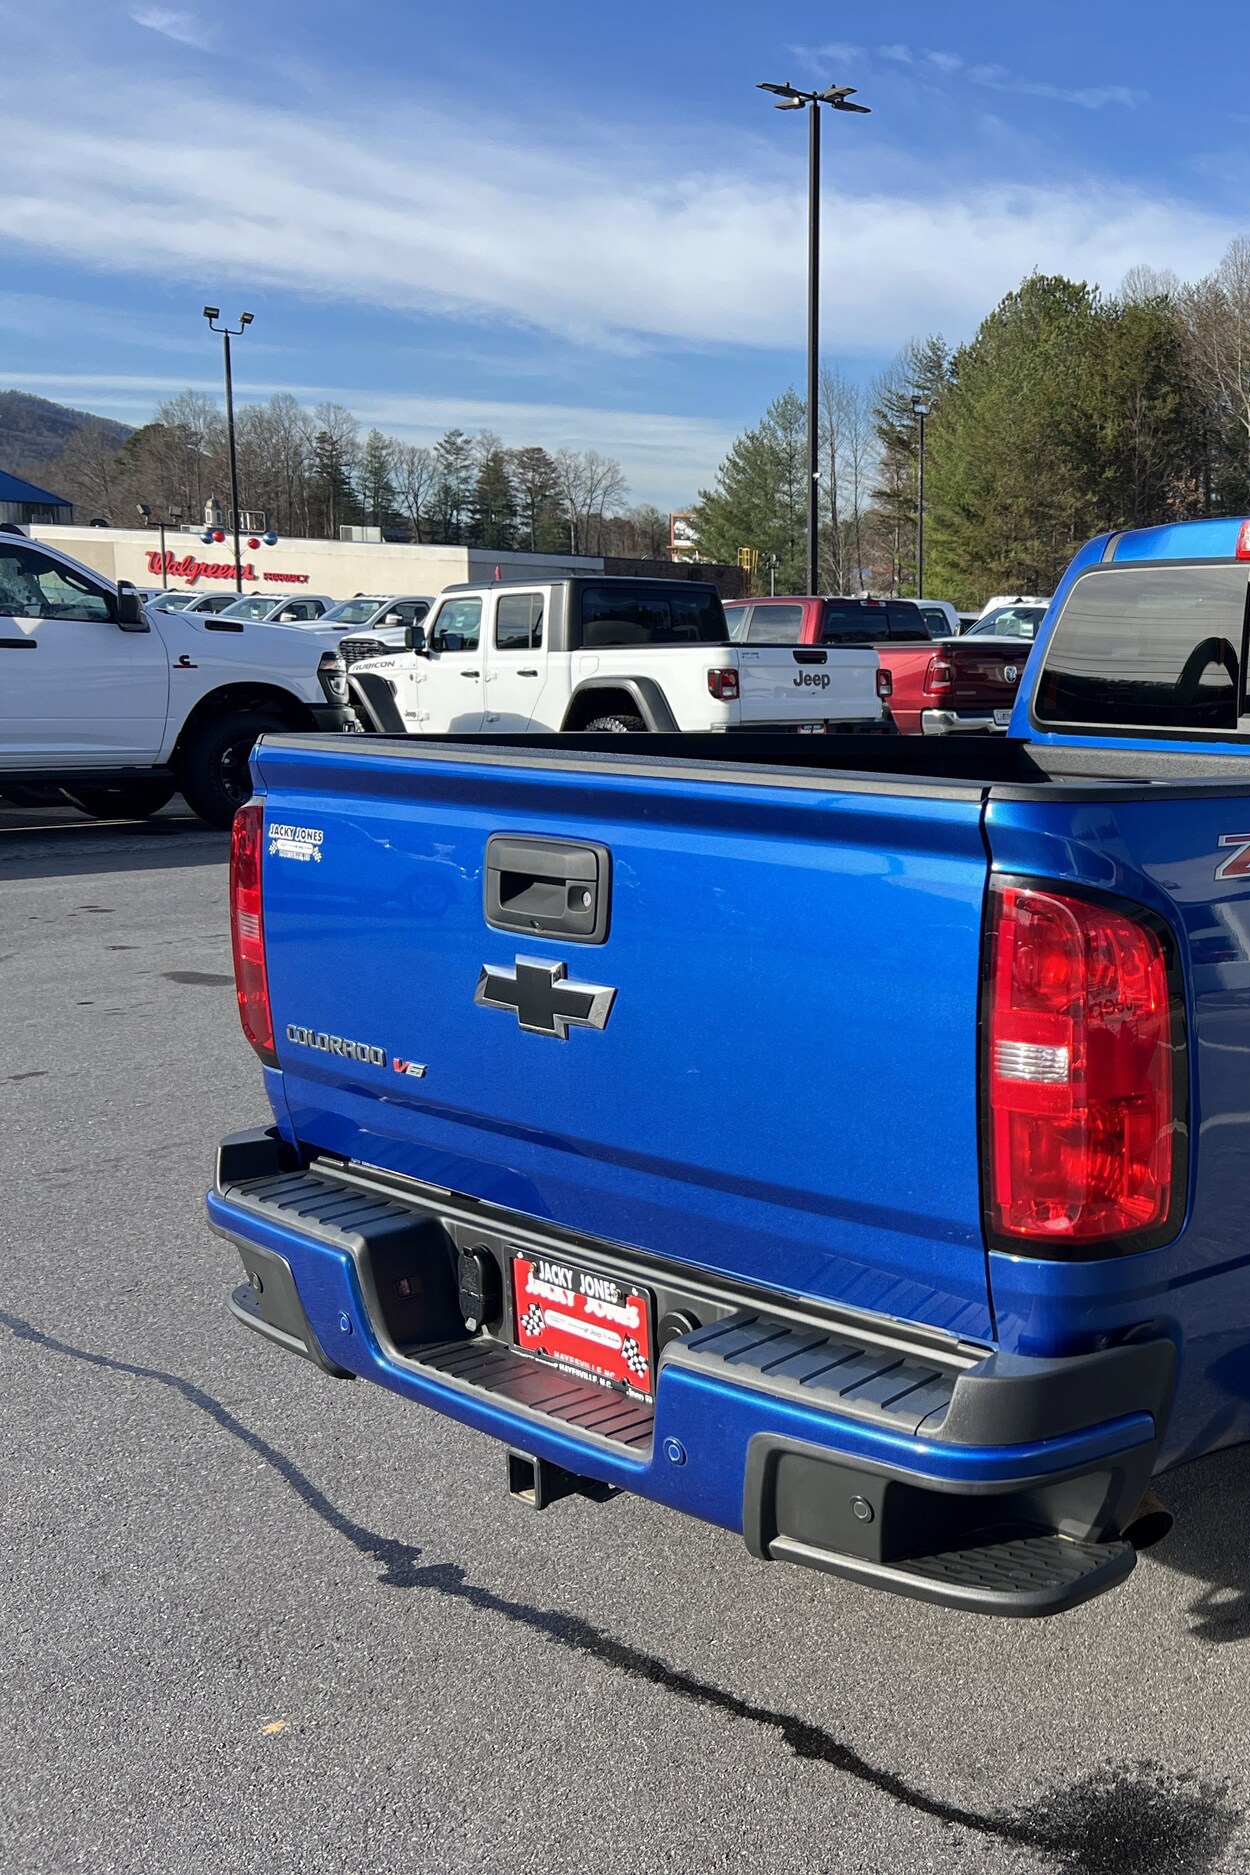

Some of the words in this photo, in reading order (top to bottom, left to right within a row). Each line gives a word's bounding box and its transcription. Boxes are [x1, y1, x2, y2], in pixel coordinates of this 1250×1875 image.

[145, 550, 259, 584] Walgreens
[352, 660, 395, 671] RUBICON
[793, 670, 831, 689] Jeep
[269, 824, 294, 839] JACKY
[296, 827, 324, 843] JONES
[286, 1024, 388, 1067] COLORADO
[392, 1057, 428, 1079] V6
[539, 1260, 574, 1289] JACKY
[580, 1273, 618, 1303] JONES
